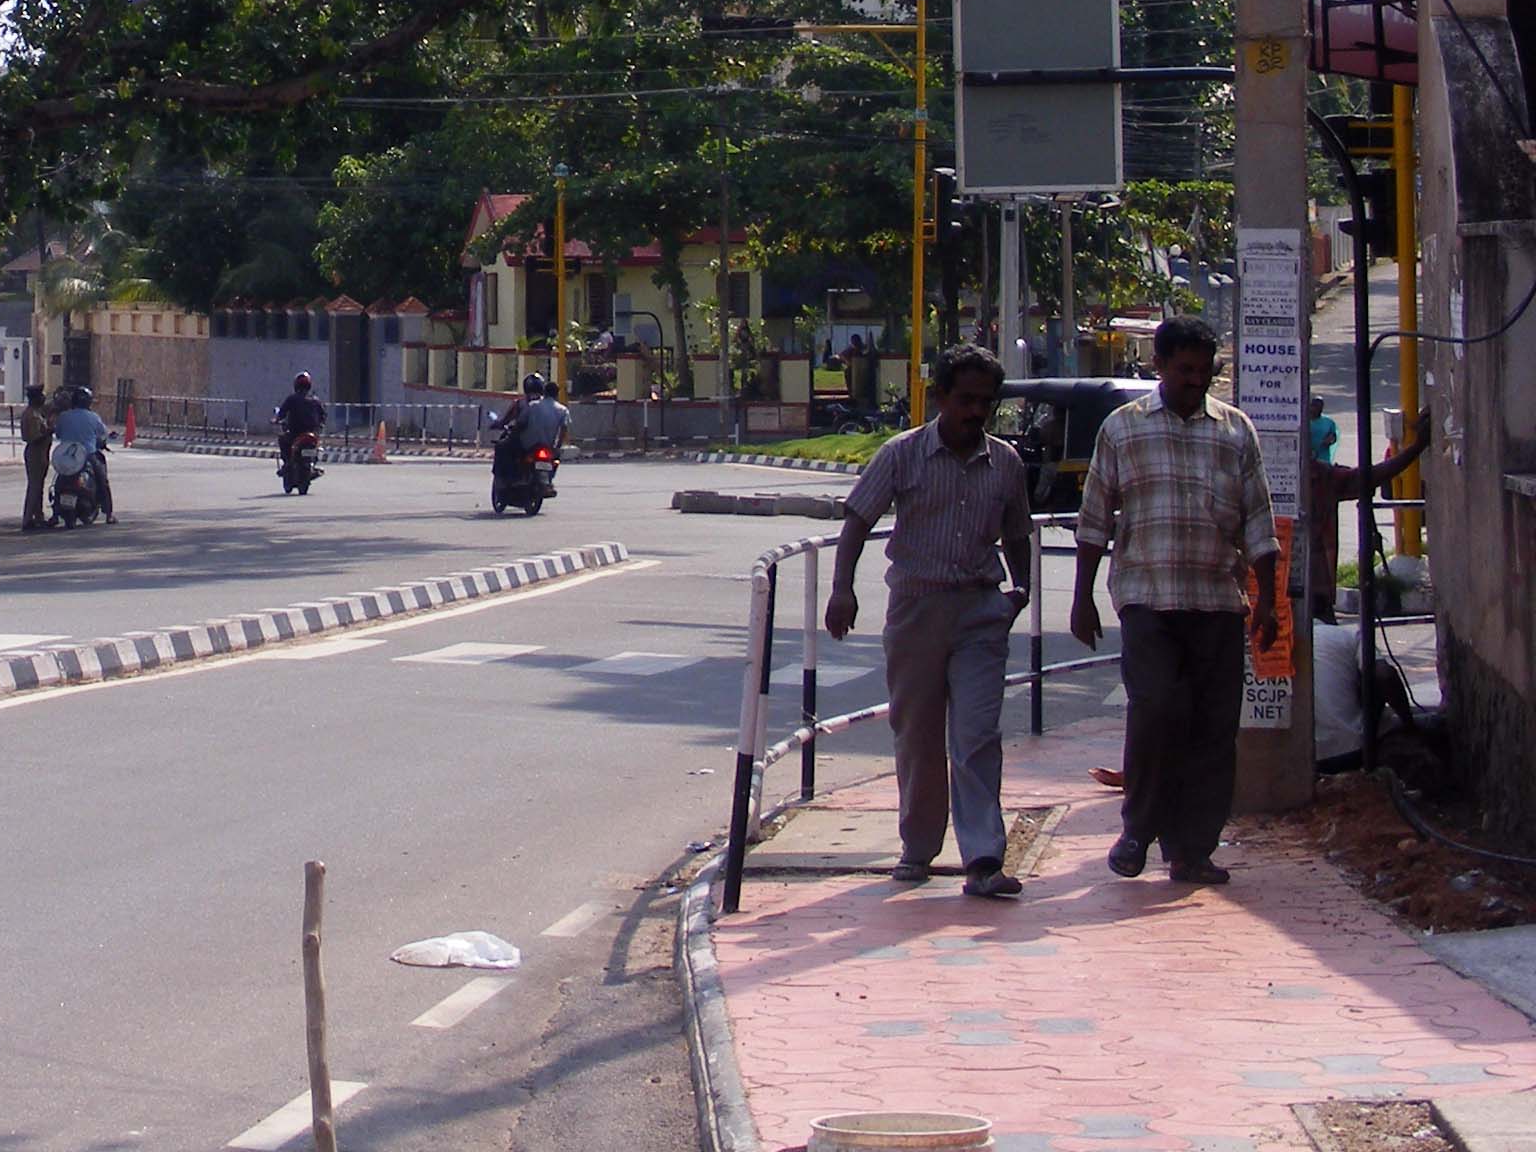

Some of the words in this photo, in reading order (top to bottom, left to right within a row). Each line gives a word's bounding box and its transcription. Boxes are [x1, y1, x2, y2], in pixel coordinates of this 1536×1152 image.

[1245, 344, 1297, 355] HOUSE
[1242, 365, 1299, 374] FLAT,PLOT
[1260, 380, 1281, 388] FOR
[1246, 689, 1287, 702] SCJP
[1249, 705, 1284, 719] .NET
